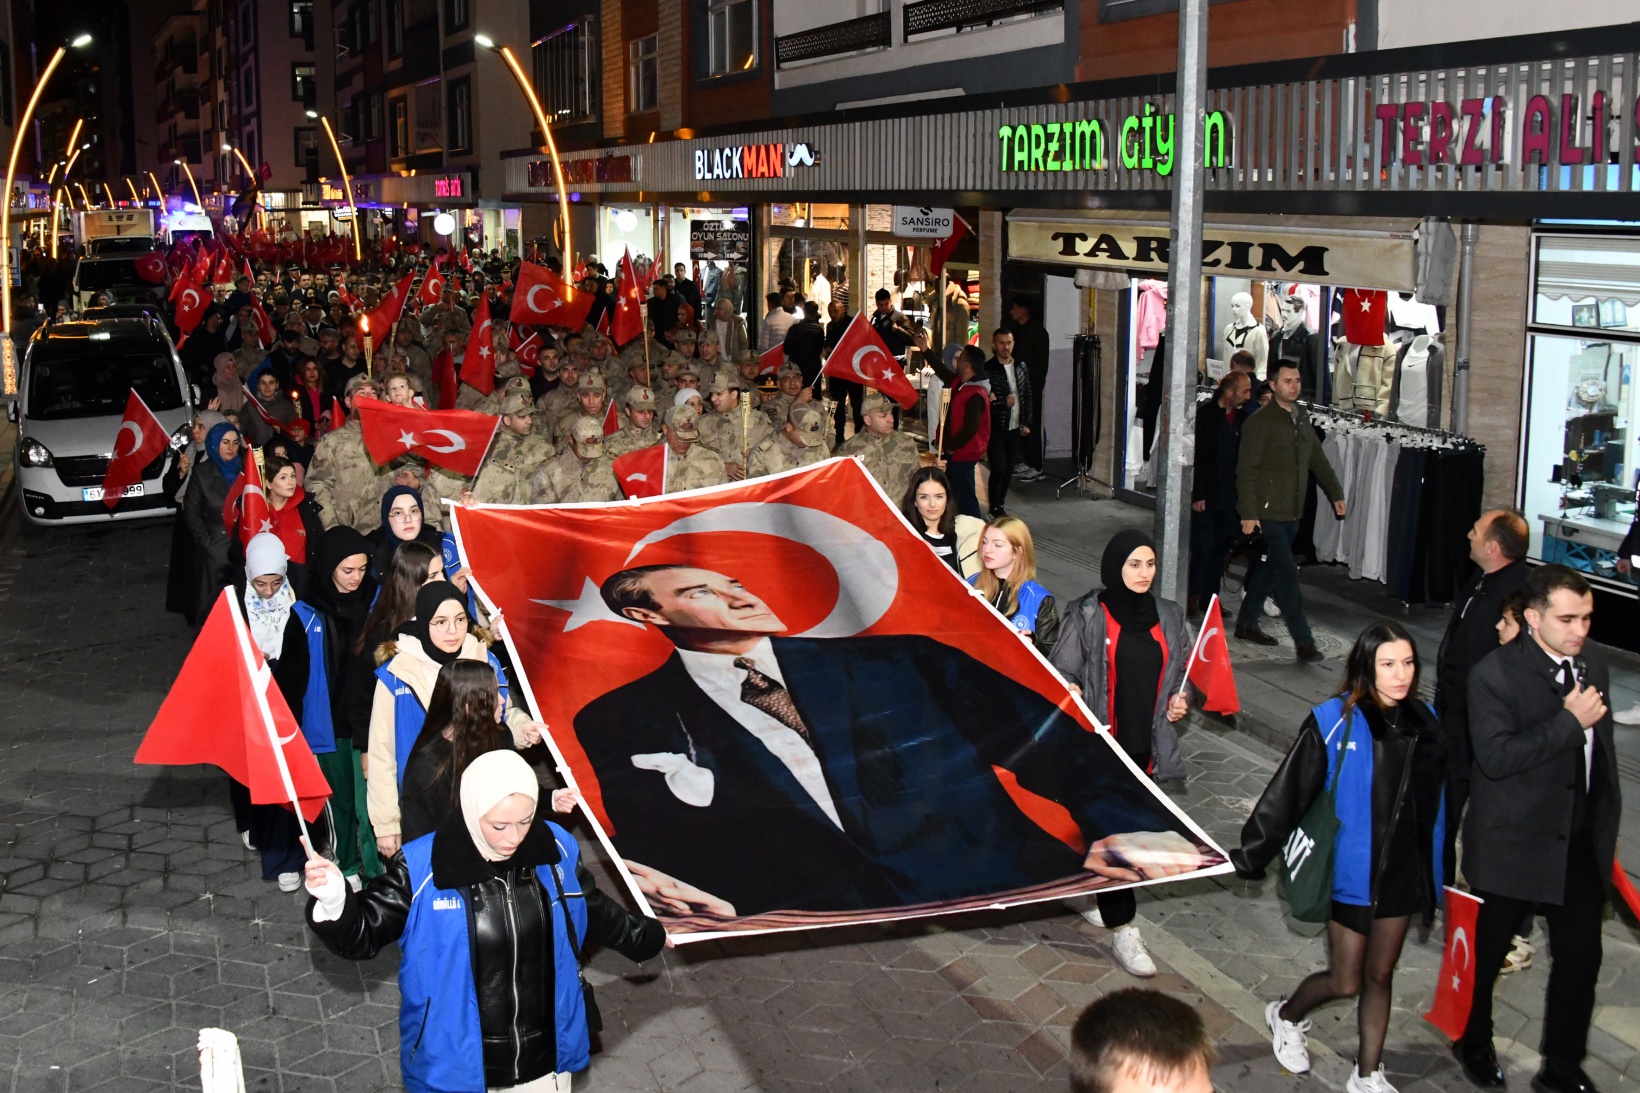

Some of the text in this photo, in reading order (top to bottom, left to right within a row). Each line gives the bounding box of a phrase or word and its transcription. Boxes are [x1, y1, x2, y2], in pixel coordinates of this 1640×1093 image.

[695, 143, 783, 180] BLACKMAN
[691, 231, 749, 241] OYUN SALONU
[702, 220, 737, 232] ÖZTK
[1051, 231, 1330, 277] TARZIM
